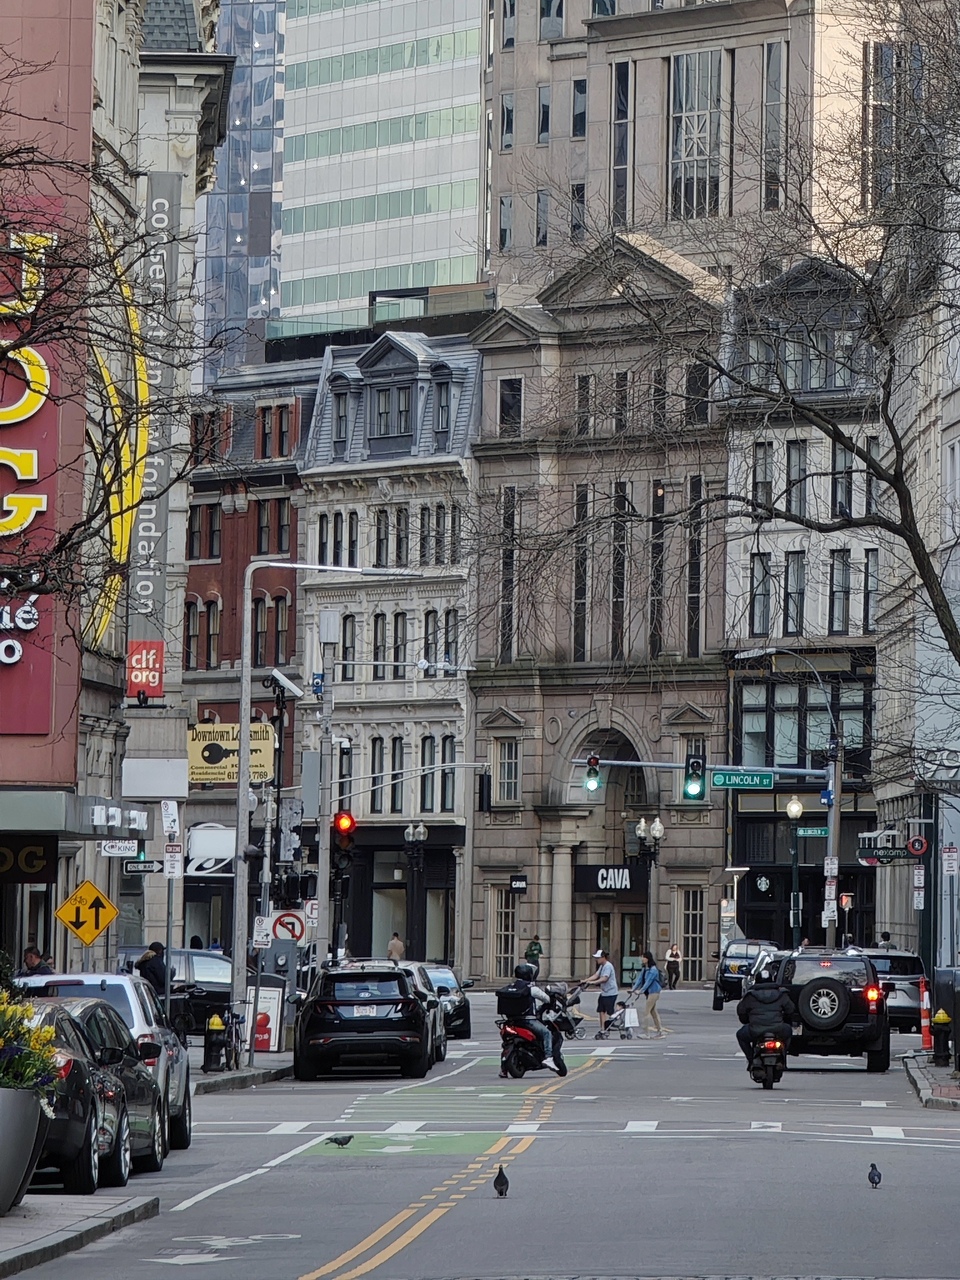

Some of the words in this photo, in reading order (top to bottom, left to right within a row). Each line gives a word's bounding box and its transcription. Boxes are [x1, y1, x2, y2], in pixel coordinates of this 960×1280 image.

[147, 198, 170, 386] conseraton
[136, 455, 165, 614] foundation
[130, 649, 160, 669] clf.
[130, 667, 159, 687] org
[191, 727, 230, 742] Downtown
[231, 724, 270, 742] Losmith
[227, 771, 239, 780] 617
[252, 771, 268, 780] 7769
[725, 776, 760, 785] LINCOLN
[117, 844, 136, 852] KING
[873, 849, 907, 858] nexamp
[597, 868, 631, 889] CAVA
